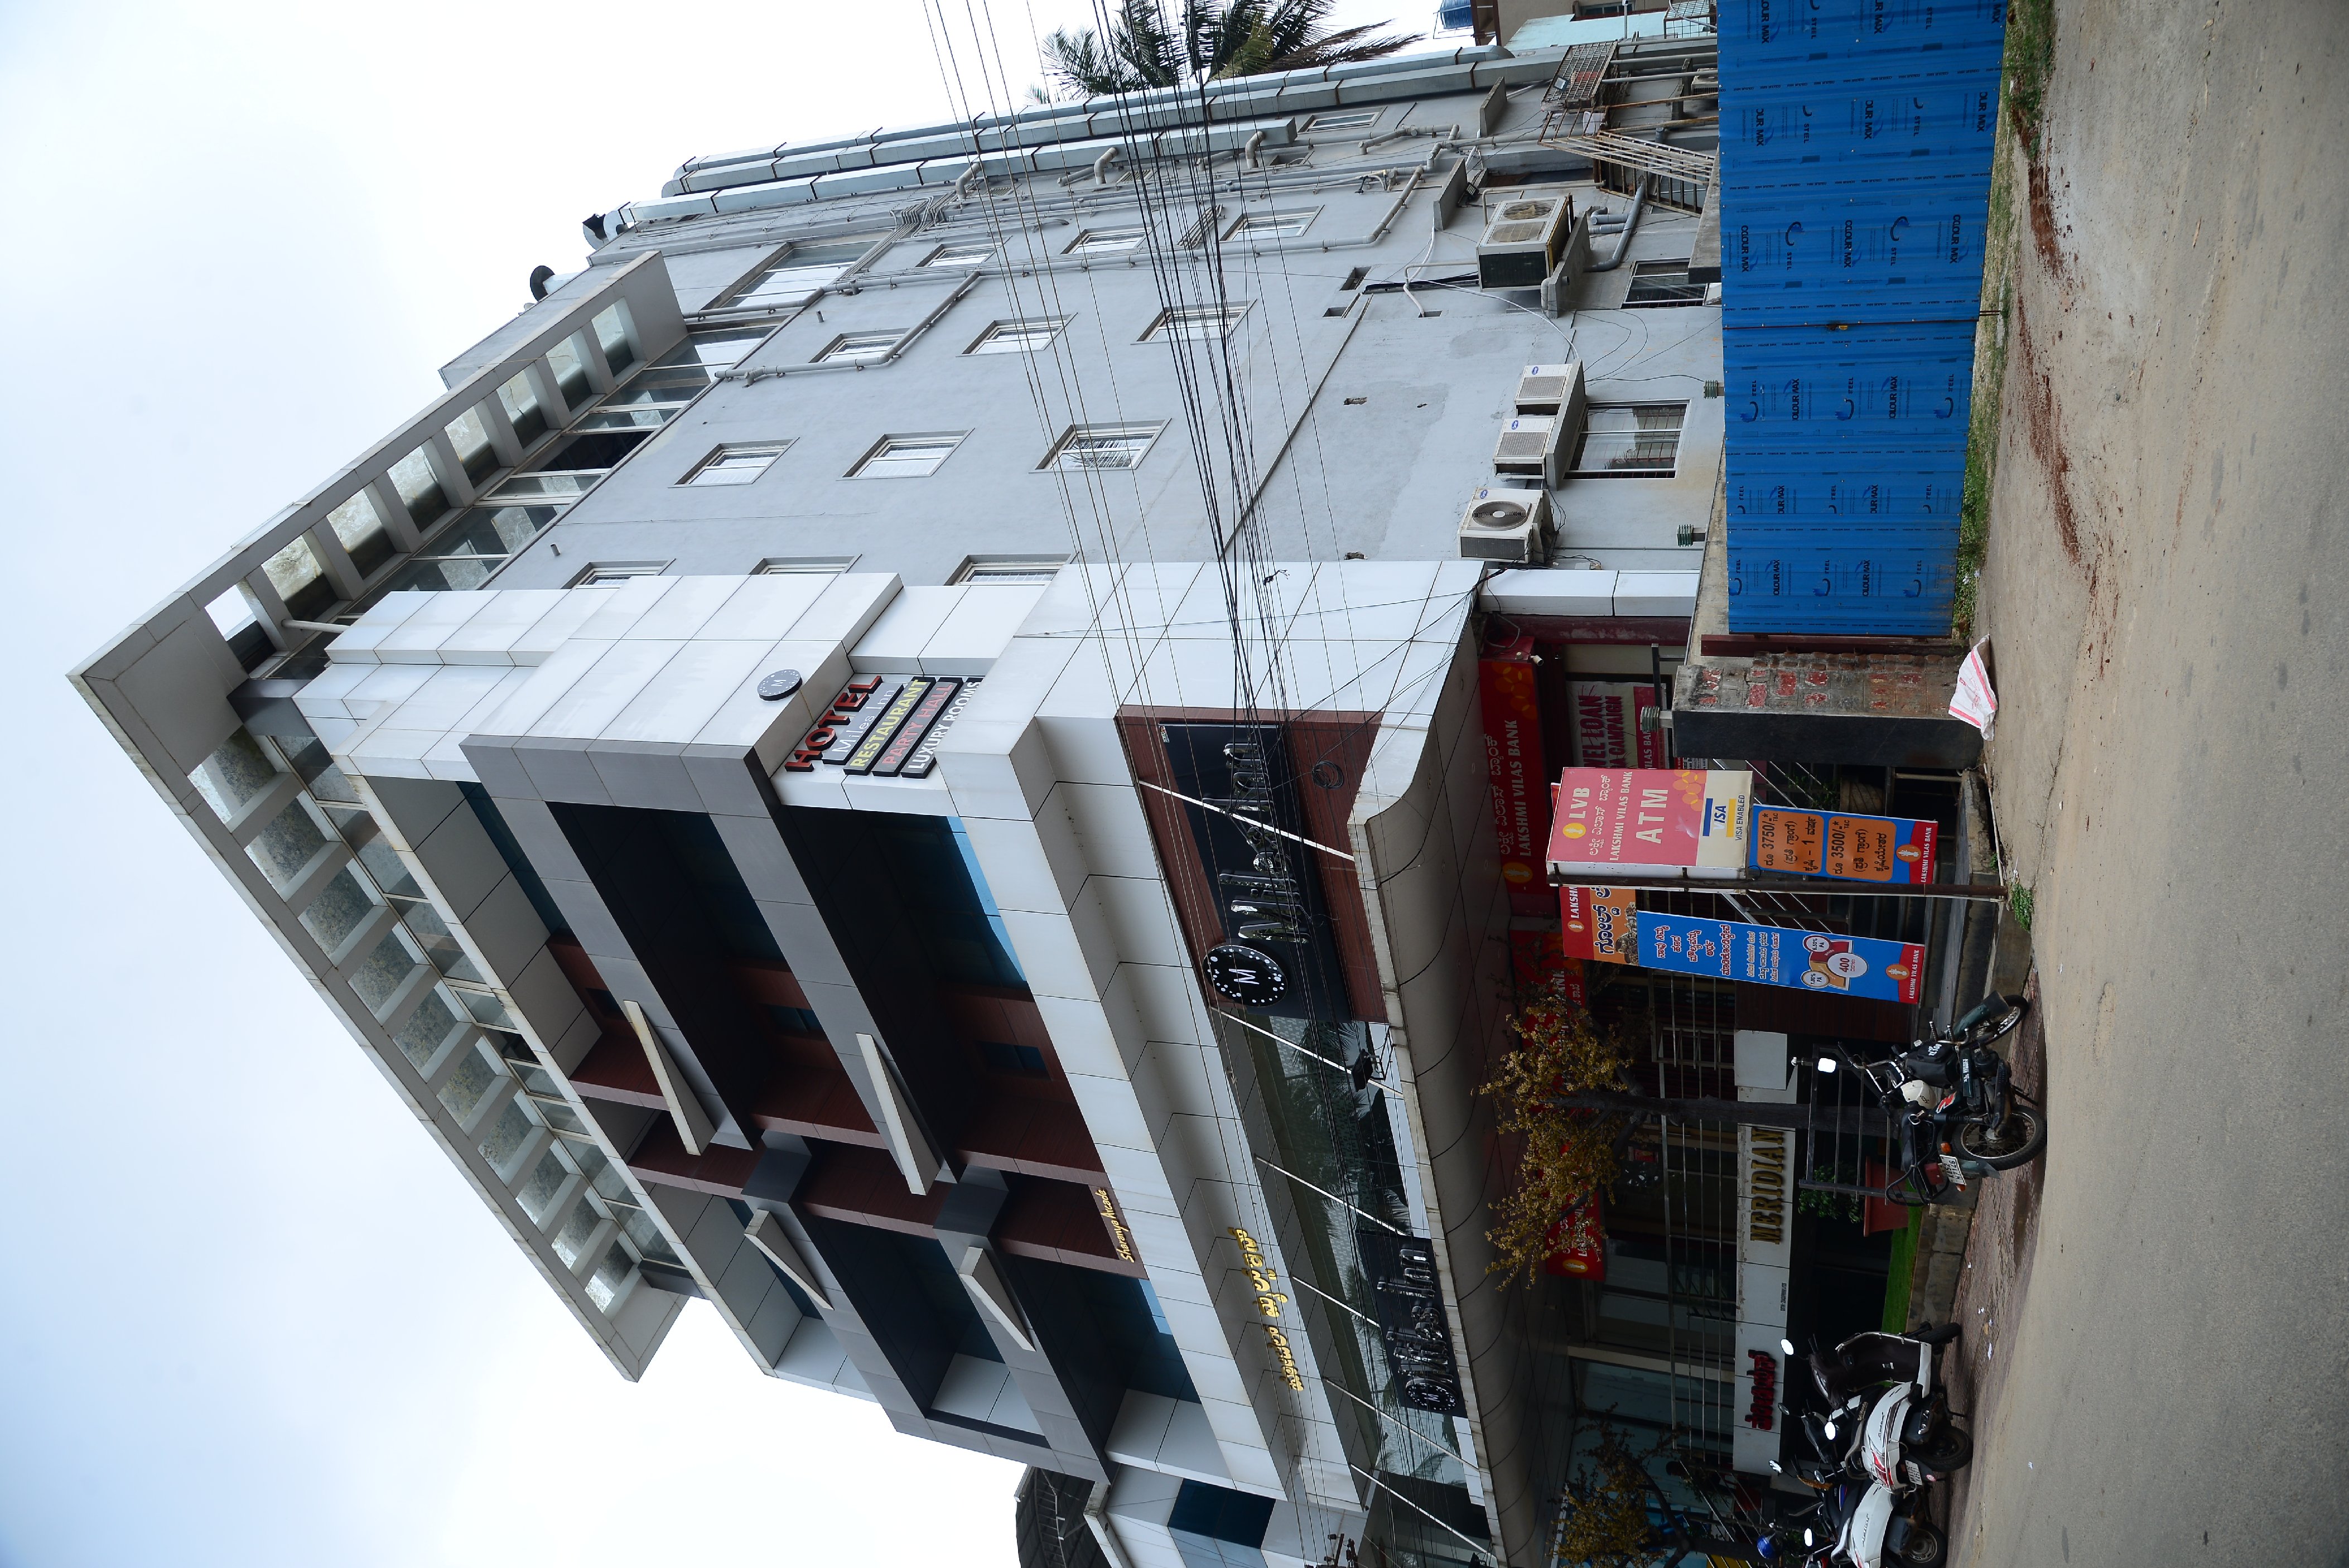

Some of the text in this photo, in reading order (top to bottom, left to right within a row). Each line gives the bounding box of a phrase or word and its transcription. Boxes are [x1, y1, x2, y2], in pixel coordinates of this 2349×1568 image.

[784, 676, 883, 771] HOTEL
[831, 689, 895, 752] Miles Inn
[850, 679, 928, 766] RESTAURANT
[882, 684, 953, 764] PARTY HALL
[908, 681, 981, 769] LUXURY ROOMS
[1578, 695, 1604, 738] LOAN
[1605, 696, 1626, 756] CAMPAIGN
[1484, 733, 1504, 775] ಬ್ಯಾಂಕ್
[1490, 784, 1507, 826] ವಿಲಾಸ್
[1504, 720, 1531, 856] LAKSHMI VILAS BANK
[1569, 787, 1590, 819] LVB
[1598, 774, 1613, 801] ಬ್ಯಾಂಕ್
[1591, 805, 1606, 835] ವಿಲಾಸ್
[1609, 771, 1633, 861] LAKSHMI VILAS BANK
[1636, 789, 1668, 844] ATM
[1713, 805, 1726, 831] VISA
[1735, 794, 1745, 841] VISA ENABLED
[1202, 741, 1310, 944] Miles Inn
[1764, 854, 1774, 866] ರೂ
[1784, 849, 1799, 864] (ಪ್ರತಿ
[1873, 832, 1889, 872] ಕೃಷಿಯೇತರ
[1803, 860, 1818, 871] ಕೃಷಿ
[1833, 863, 1844, 875] ರೂ
[1853, 857, 1868, 872] (ಪ್ರತಿ
[1920, 859, 1929, 882] LAKSHMI
[1591, 904, 1621, 954] ಗೋಲ್ಡ್
[1655, 925, 1670, 958] ನಾವು ನಿಮ್ಮ
[1671, 935, 1682, 952] ಹಣದ
[1687, 930, 1702, 962] ಮೌಲ್ಯವನ್ನು
[1705, 940, 1715, 957] ಅರ್ಥ
[1720, 925, 1735, 976] ಮಾಡಿಕೊಂಡಿದ್ದೇವೆ
[1839, 957, 1850, 973] 400
[1228, 968, 1260, 985] M
[1750, 1126, 1783, 1244] MERIDIAN
[1094, 1189, 1135, 1263] Sharanya Arcade
[1376, 1248, 1454, 1383] Miles Inn
[1858, 1401, 1867, 1414] Honda
